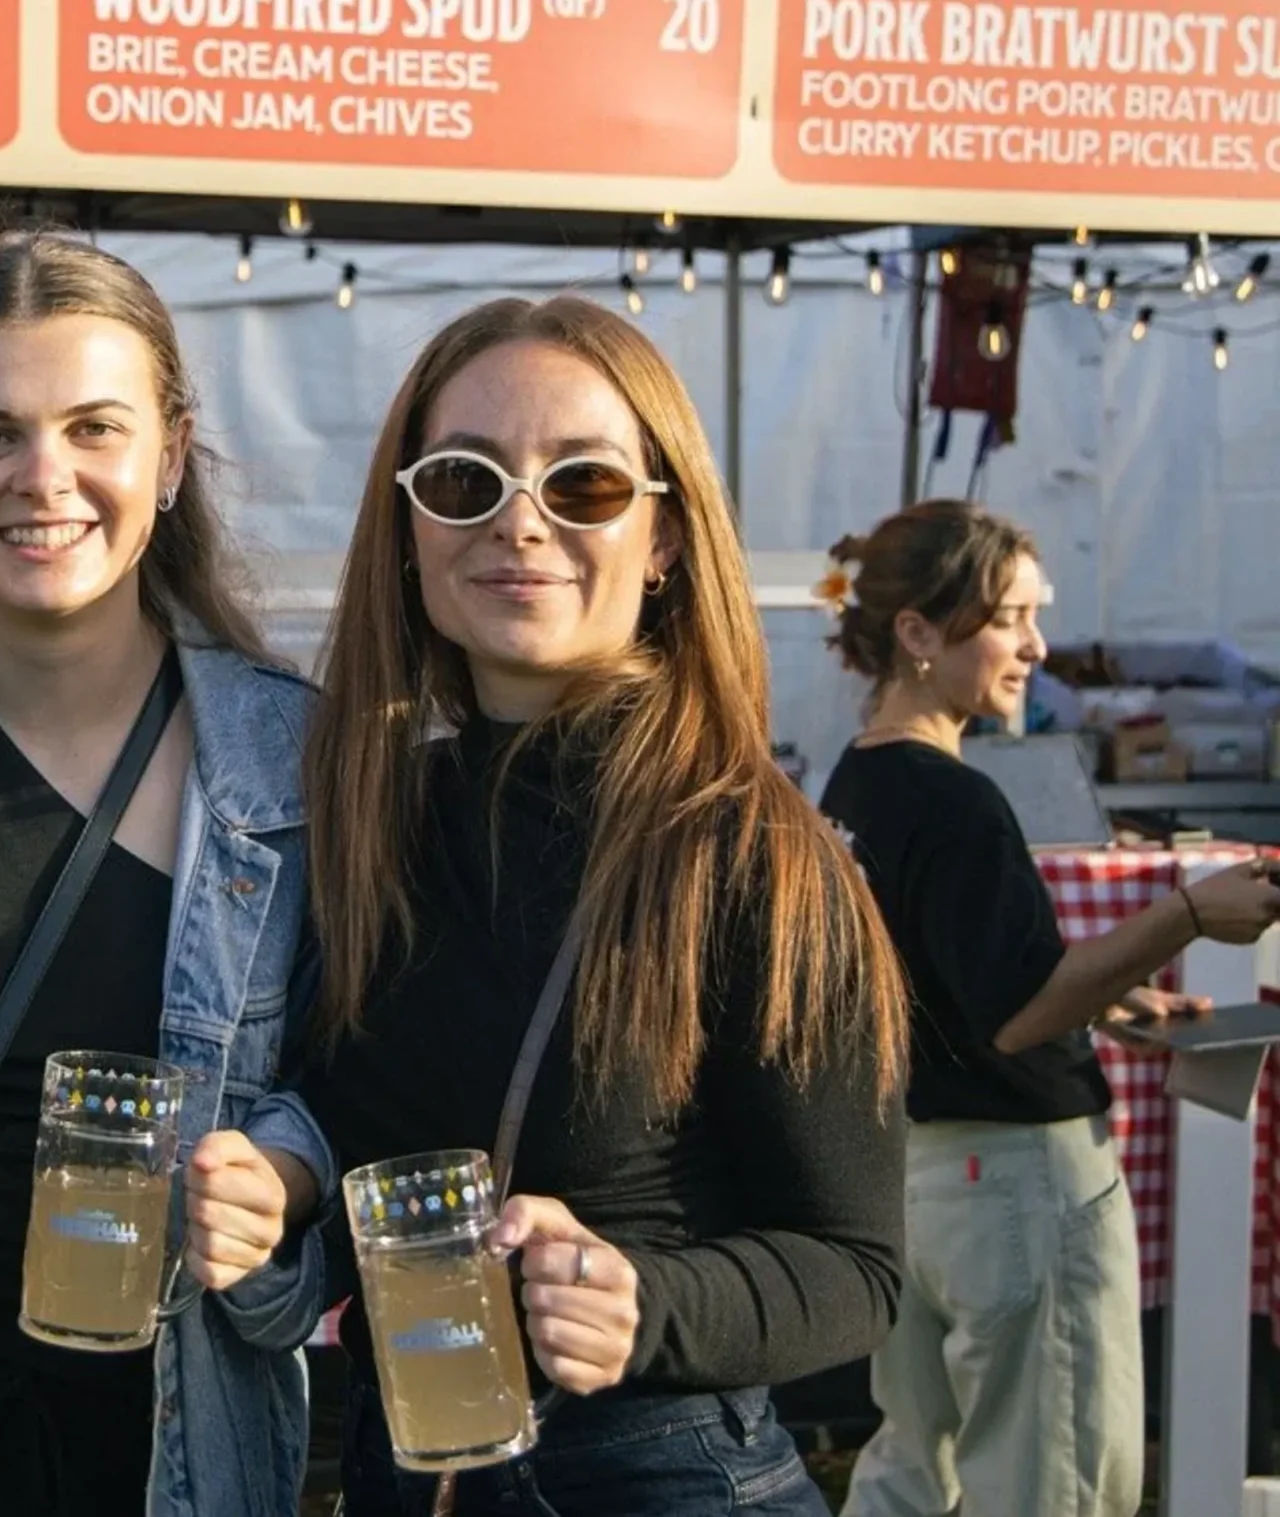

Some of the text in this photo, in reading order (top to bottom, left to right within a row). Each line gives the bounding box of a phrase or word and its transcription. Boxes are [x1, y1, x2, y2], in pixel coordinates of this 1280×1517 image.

[402, 0, 532, 42] SPUD
[659, 0, 720, 54] 20
[803, 0, 930, 62] PORK
[940, 3, 1226, 77] BRATWURST
[193, 38, 334, 83] CREAM
[86, 83, 225, 127] ONION
[329, 95, 473, 140] CHIVES
[801, 69, 1280, 126] FOOTLONG PORK BRATWU
[797, 117, 922, 158] CURRY
